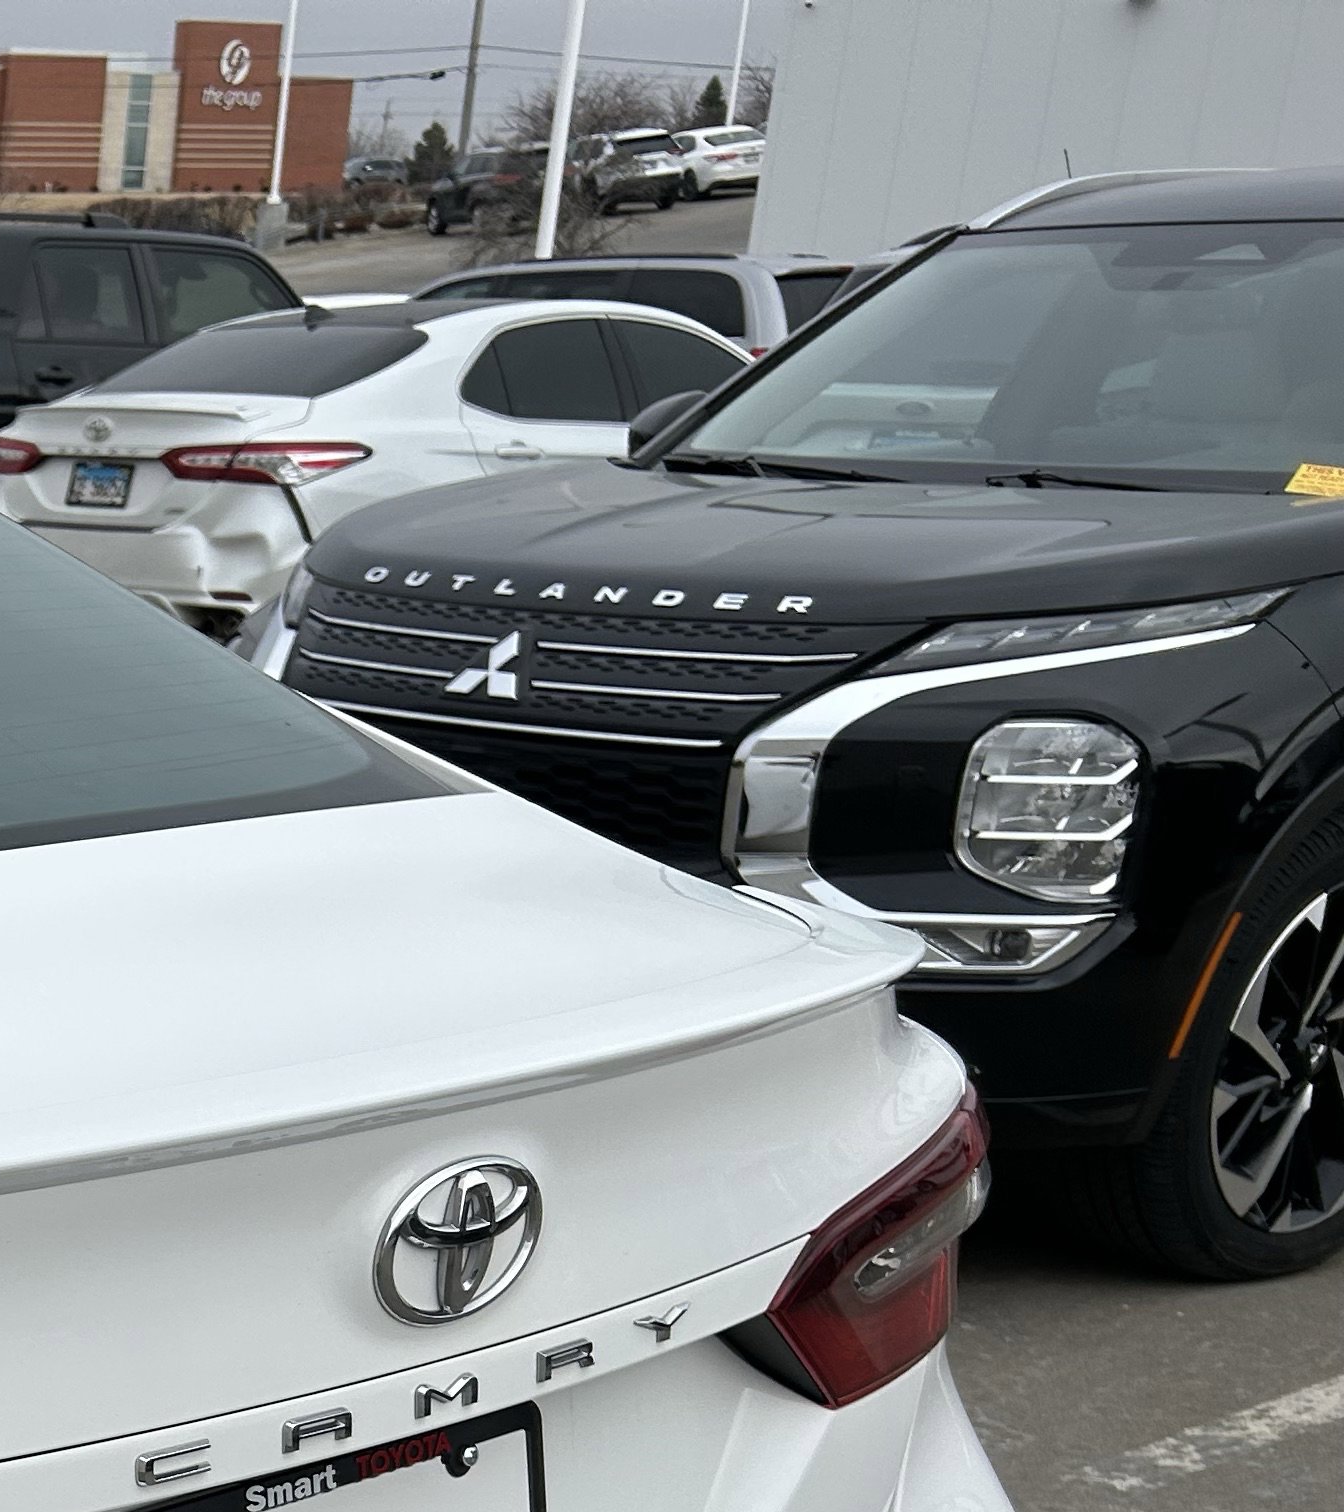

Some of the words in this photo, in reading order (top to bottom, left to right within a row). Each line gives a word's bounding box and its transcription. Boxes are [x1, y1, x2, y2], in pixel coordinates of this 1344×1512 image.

[363, 565, 815, 615] OUTLANDER
[135, 1300, 692, 1488] CAMRY
[354, 1431, 453, 1479] TOYOTA
